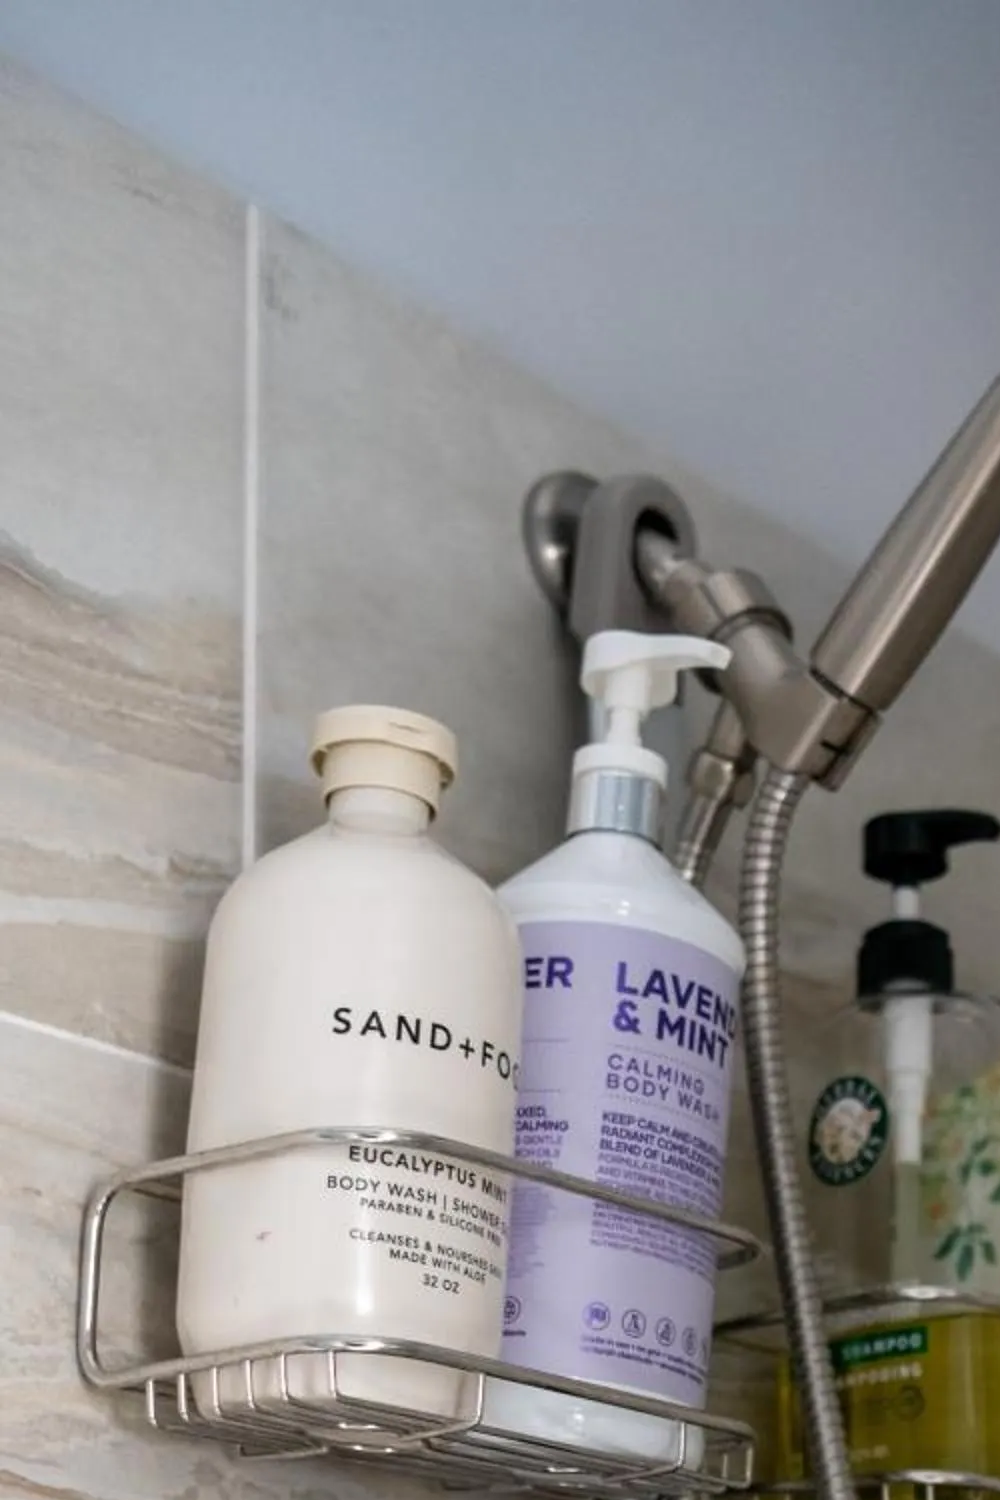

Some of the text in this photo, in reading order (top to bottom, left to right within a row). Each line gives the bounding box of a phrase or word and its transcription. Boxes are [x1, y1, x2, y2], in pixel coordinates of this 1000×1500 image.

[613, 1000, 729, 1069] & MINT
[607, 1053, 705, 1096] CALMING
[606, 1073, 669, 1101] BODY
[602, 1111, 636, 1126] KEEP
[600, 1124, 656, 1145] RADIANT
[600, 1137, 642, 1157] BLEND
[643, 1147, 659, 1160] OF
[348, 1145, 477, 1188] EUCALYPTUS
[327, 1175, 380, 1193] BODY
[387, 1182, 437, 1204] WASH
[360, 1196, 422, 1217] PARABEN
[349, 1227, 419, 1249] CLEANSES
[389, 1247, 427, 1265] MADE
[432, 1257, 460, 1273] WITH
[441, 1279, 460, 1294] OZ
